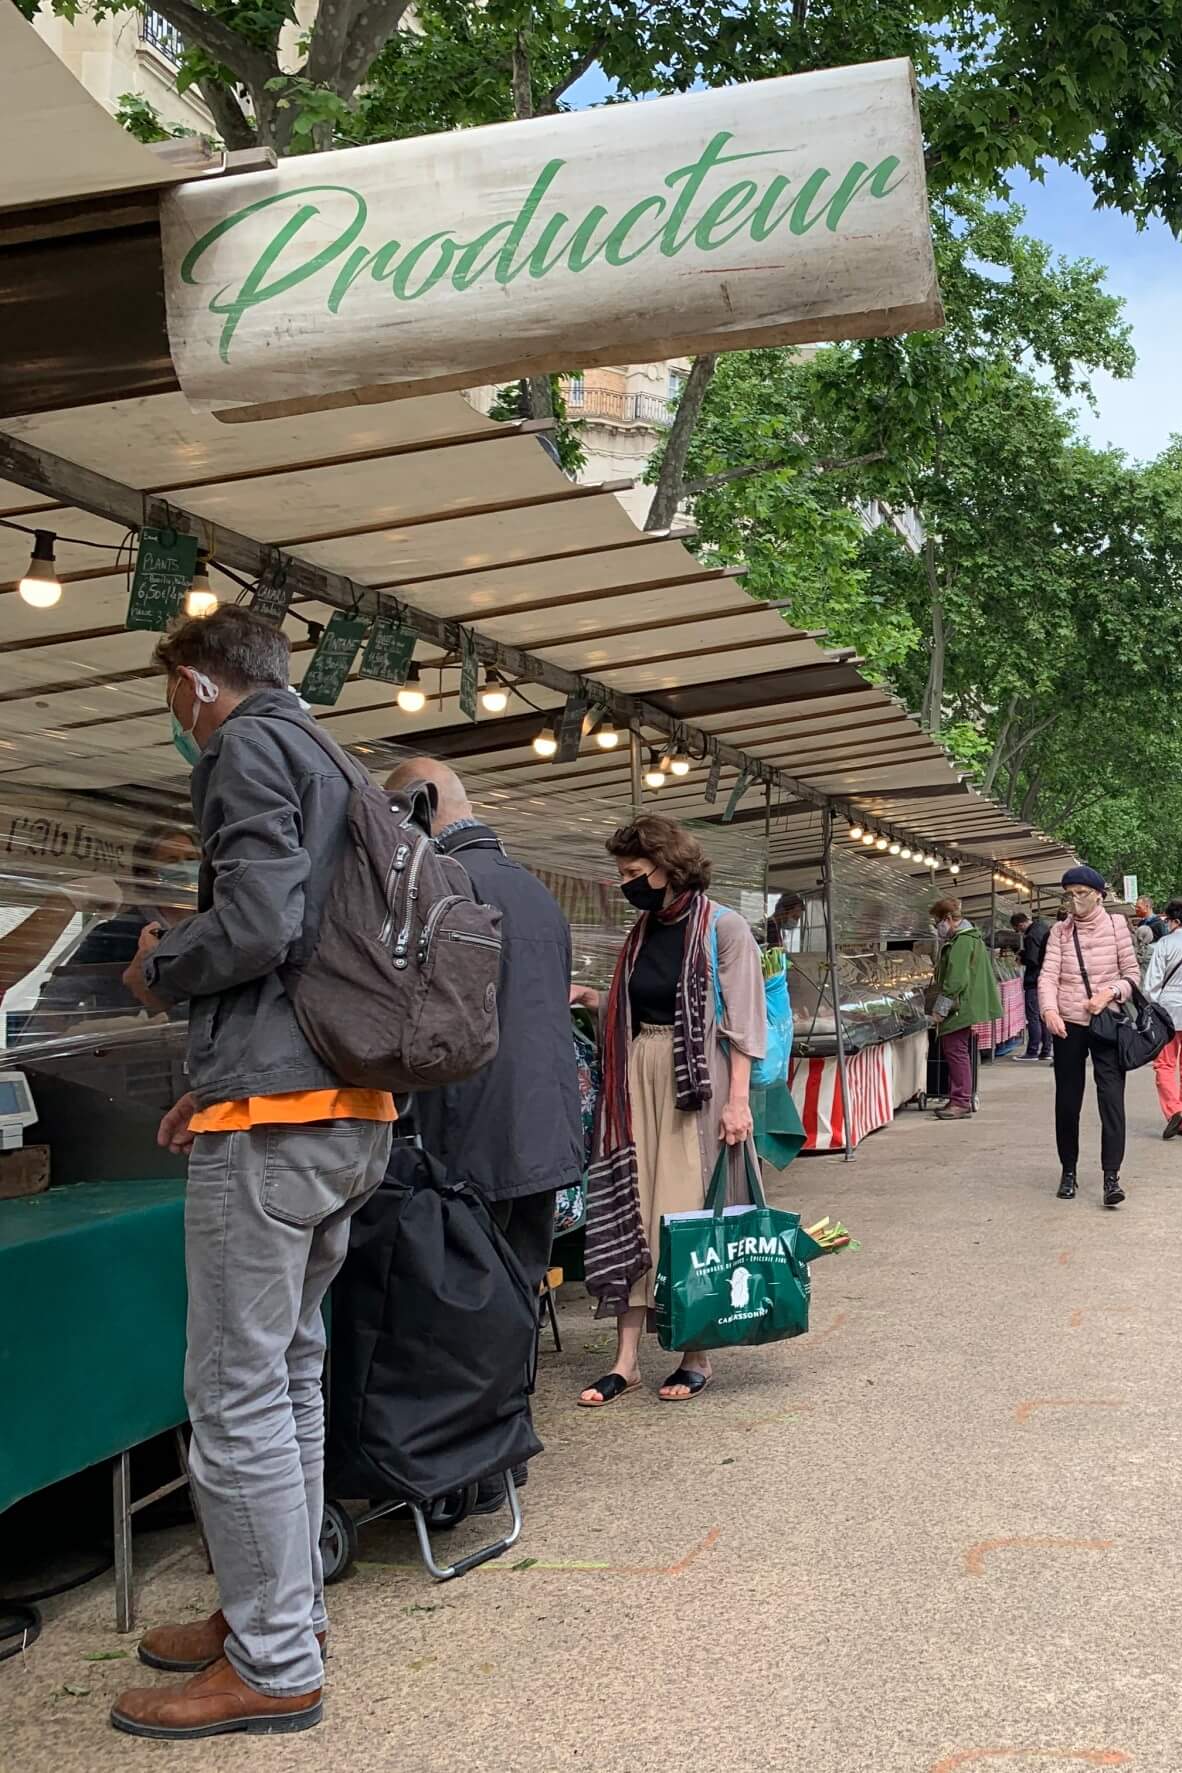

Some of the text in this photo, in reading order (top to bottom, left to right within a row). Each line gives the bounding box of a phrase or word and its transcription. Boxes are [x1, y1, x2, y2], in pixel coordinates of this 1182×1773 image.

[181, 130, 908, 365] Producteur
[143, 552, 180, 571] PLANTS
[690, 1246, 721, 1270] LA
